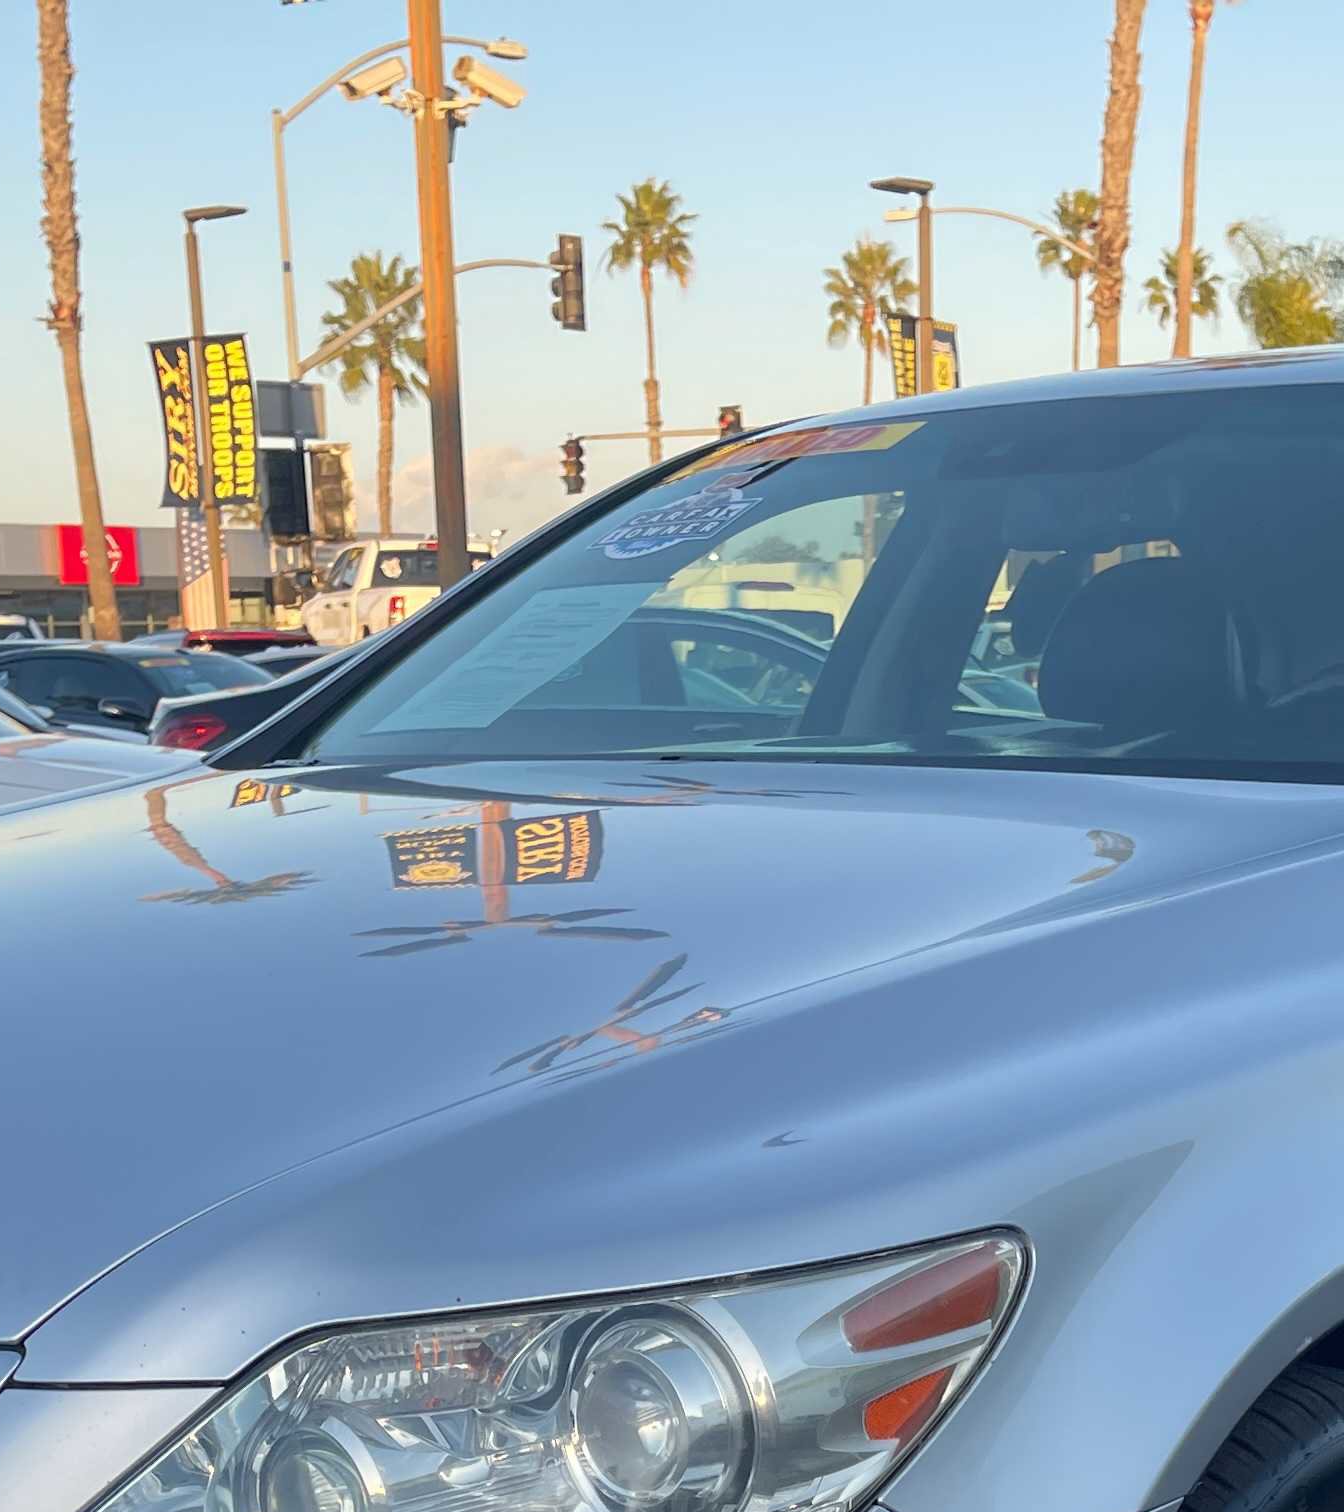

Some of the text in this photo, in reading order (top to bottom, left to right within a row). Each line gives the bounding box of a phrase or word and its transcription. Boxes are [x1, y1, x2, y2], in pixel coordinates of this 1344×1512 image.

[205, 344, 234, 499] OUR TROOPS
[225, 340, 255, 497] WE SUPPORT
[628, 520, 722, 541] OWNER
